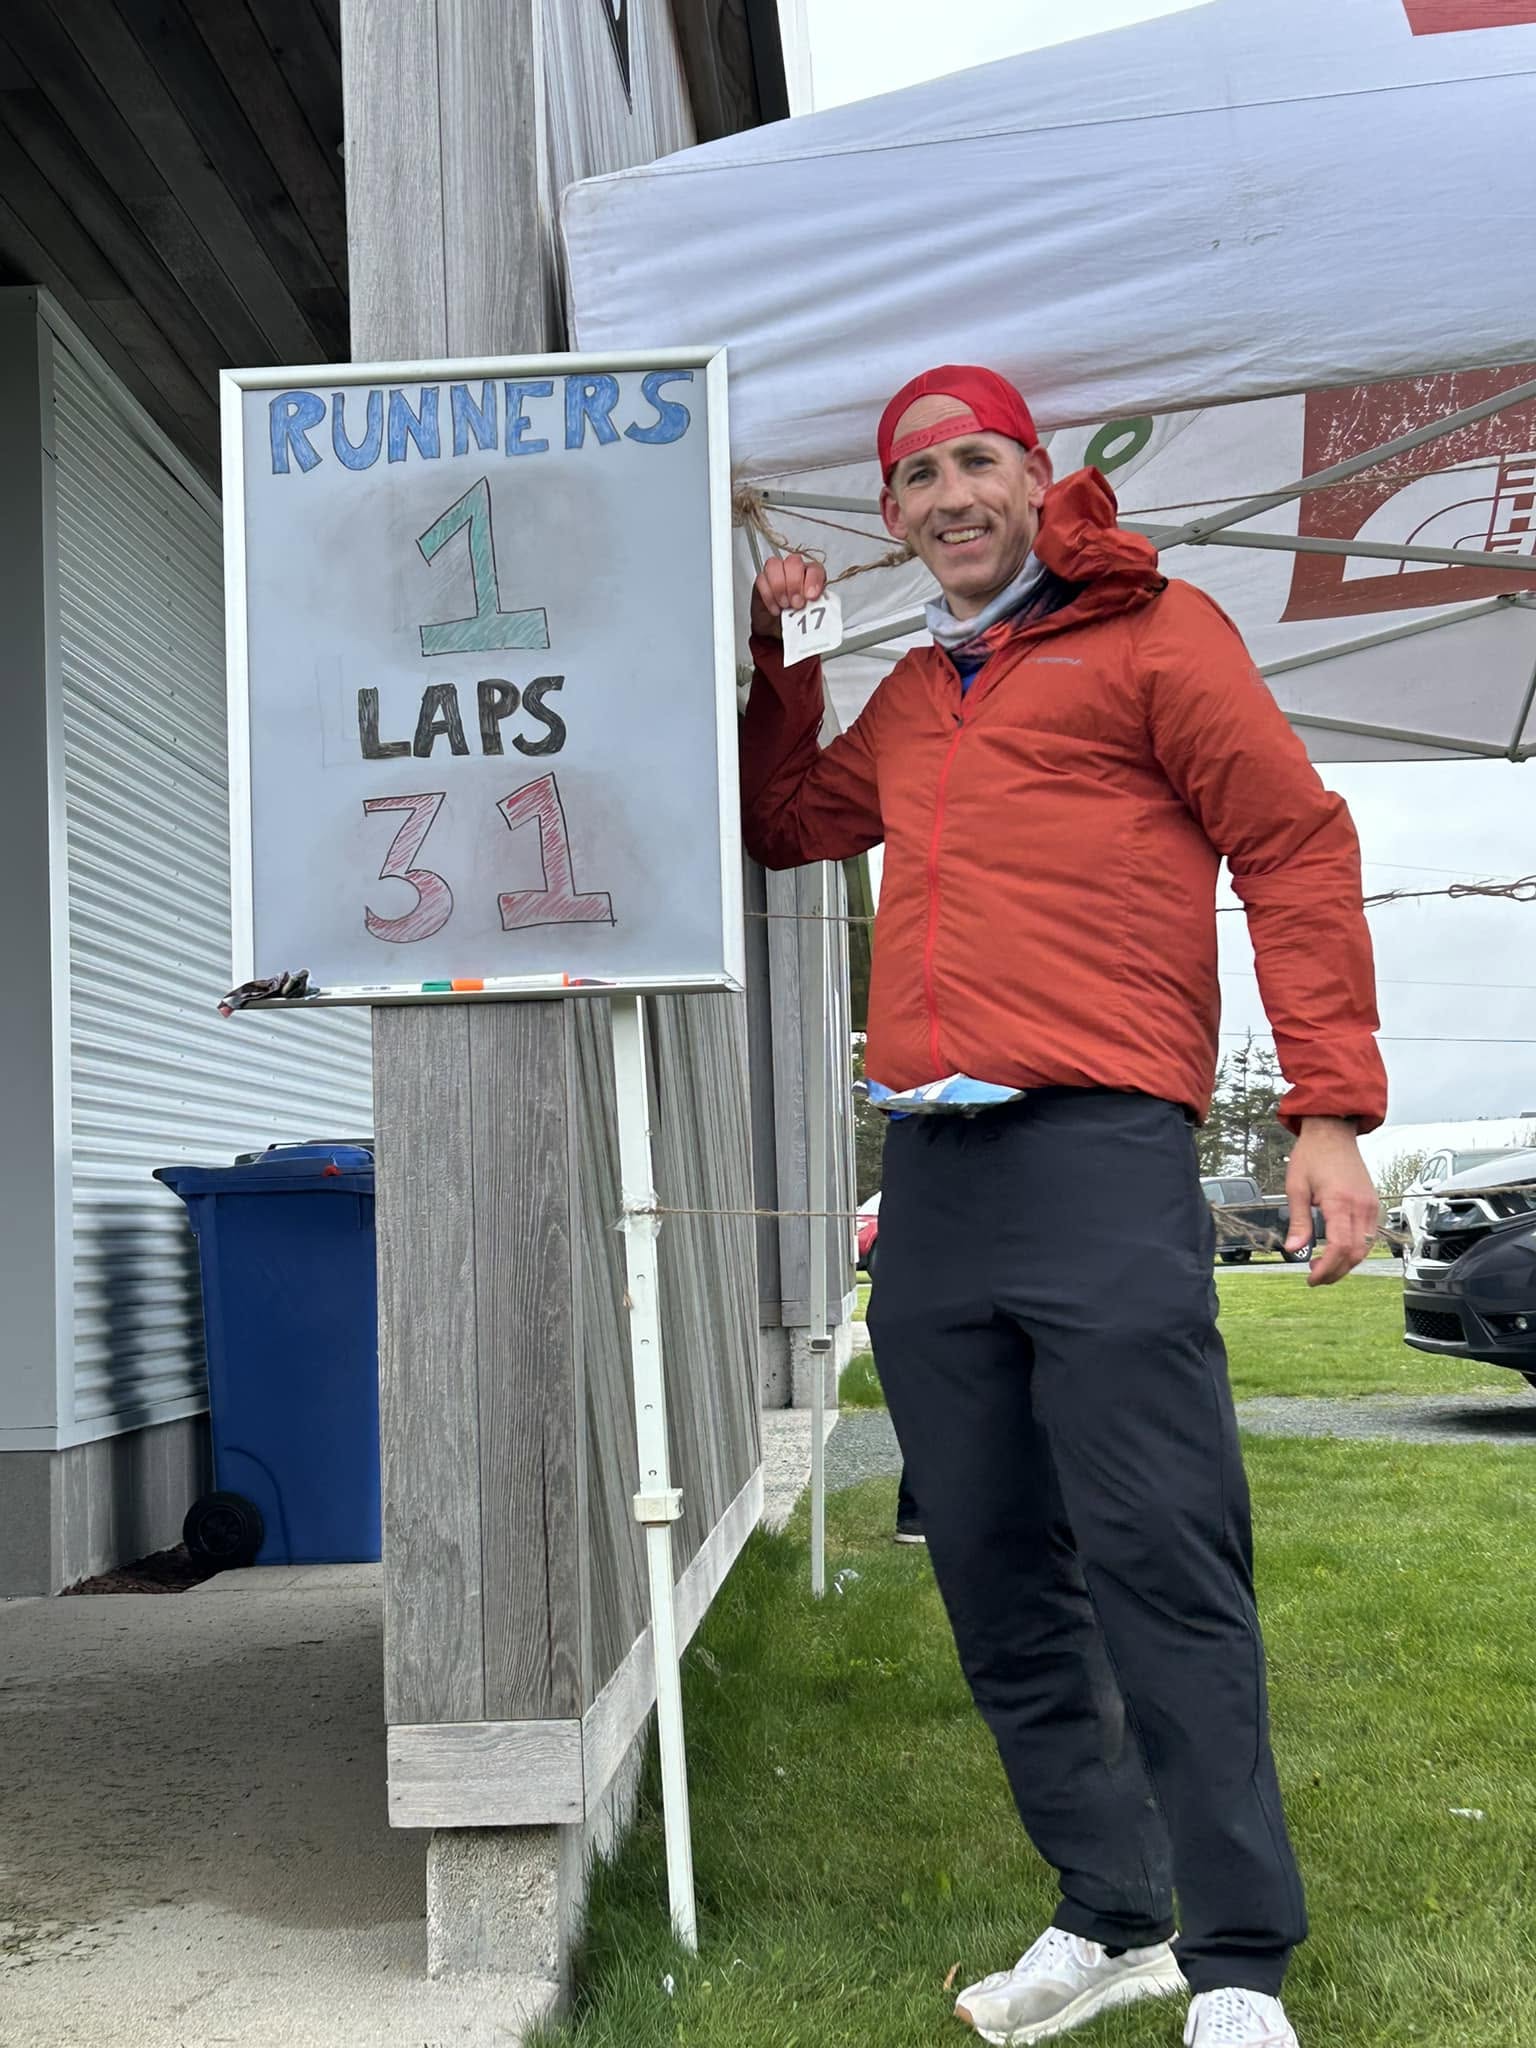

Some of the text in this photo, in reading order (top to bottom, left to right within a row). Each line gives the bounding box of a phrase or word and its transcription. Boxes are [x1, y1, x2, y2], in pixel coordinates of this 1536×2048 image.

[269, 370, 694, 474] RUNNERS
[416, 476, 550, 657] 1
[797, 606, 826, 635] 17
[357, 675, 567, 760] LAPS
[363, 772, 617, 943] 31
